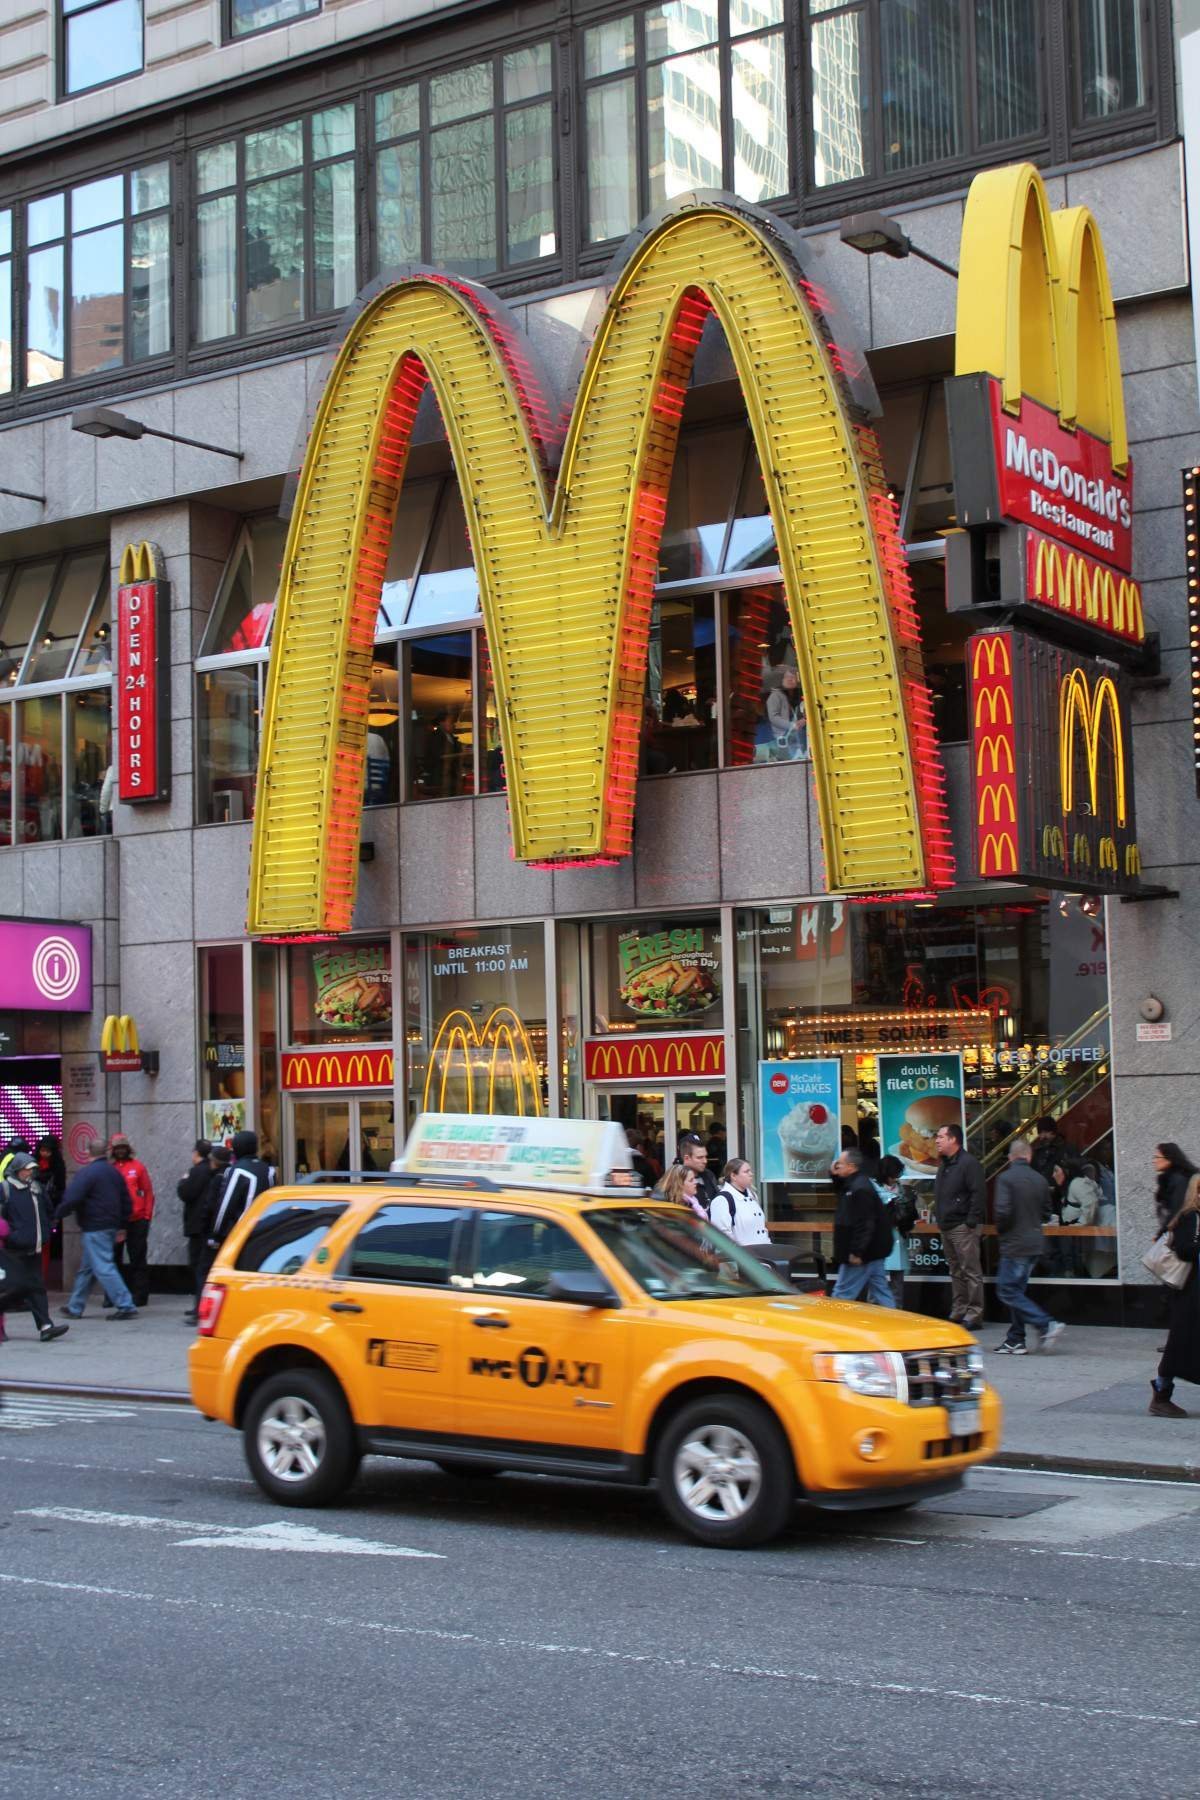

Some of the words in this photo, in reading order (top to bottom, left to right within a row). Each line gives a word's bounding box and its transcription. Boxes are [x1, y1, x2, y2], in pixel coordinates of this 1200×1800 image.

[1006, 428, 1131, 529] McDonald's
[1030, 489, 1115, 551] Restaurant
[129, 596, 141, 667] OPEN
[125, 674, 146, 691] 24
[129, 697, 142, 787] HOURS
[448, 944, 512, 959] BREAKFAST
[619, 928, 704, 972] FRESH
[314, 947, 384, 988] FRESH
[433, 963, 468, 976] UNTIL
[475, 959, 505, 973] 11:00
[509, 958, 528, 970] AM
[680, 959, 698, 967] The
[700, 958, 719, 969] Day
[813, 1028, 864, 1044] TIMES
[878, 1024, 949, 1042] SQUARE
[993, 1050, 1030, 1065] ICED
[1037, 1047, 1103, 1063] COFFEE
[901, 1065, 938, 1075] double
[772, 1080, 786, 1088] new
[790, 1083, 832, 1094] SHAKES
[887, 1078, 914, 1090] filet
[929, 1077, 955, 1089] fish
